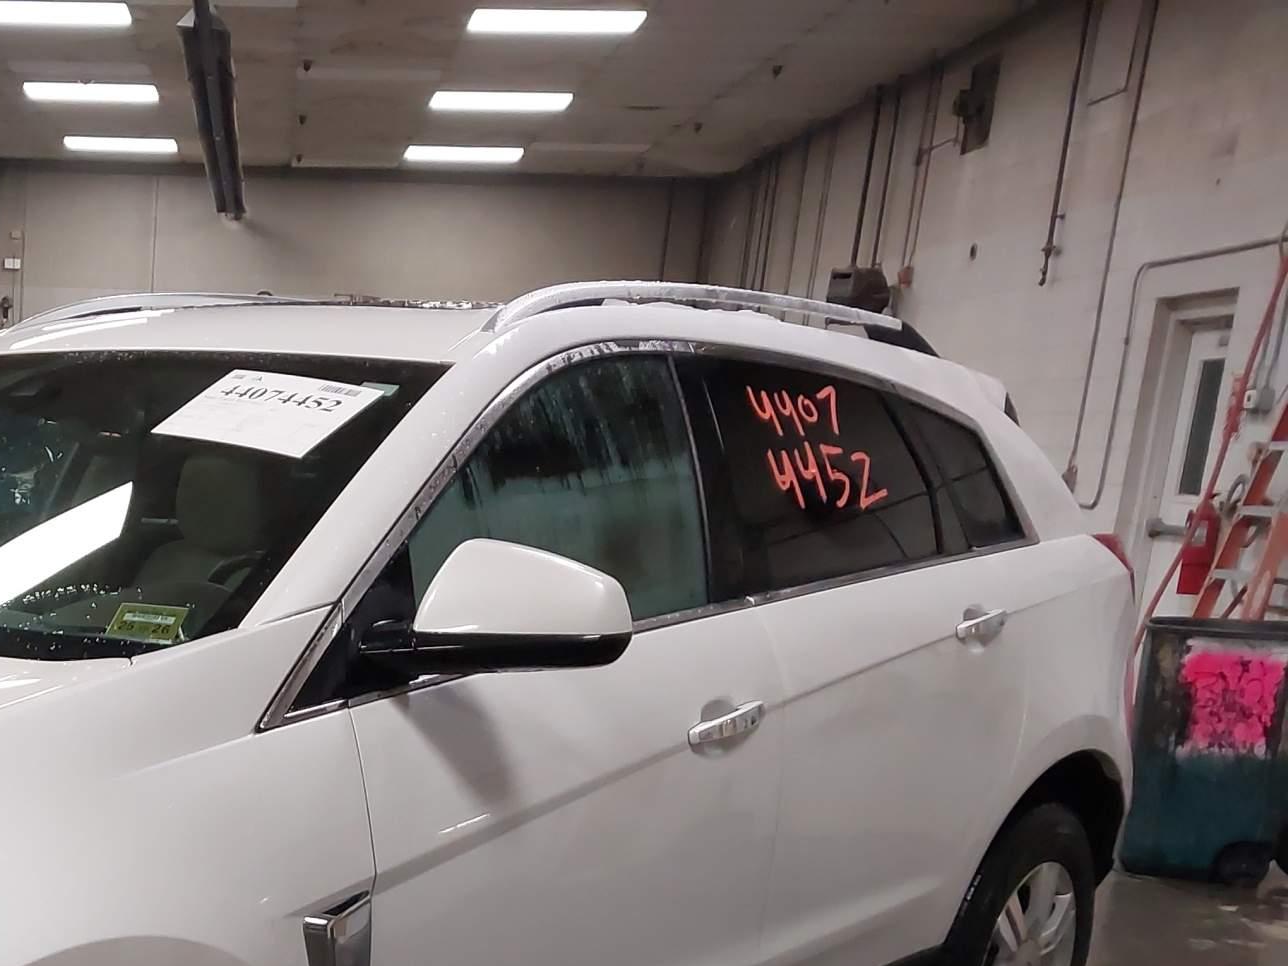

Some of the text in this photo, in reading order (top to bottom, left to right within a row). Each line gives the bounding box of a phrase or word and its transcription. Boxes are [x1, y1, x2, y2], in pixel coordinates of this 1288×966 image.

[220, 384, 344, 413] 44074452
[746, 384, 840, 437] 4407
[767, 440, 889, 511] 4452
